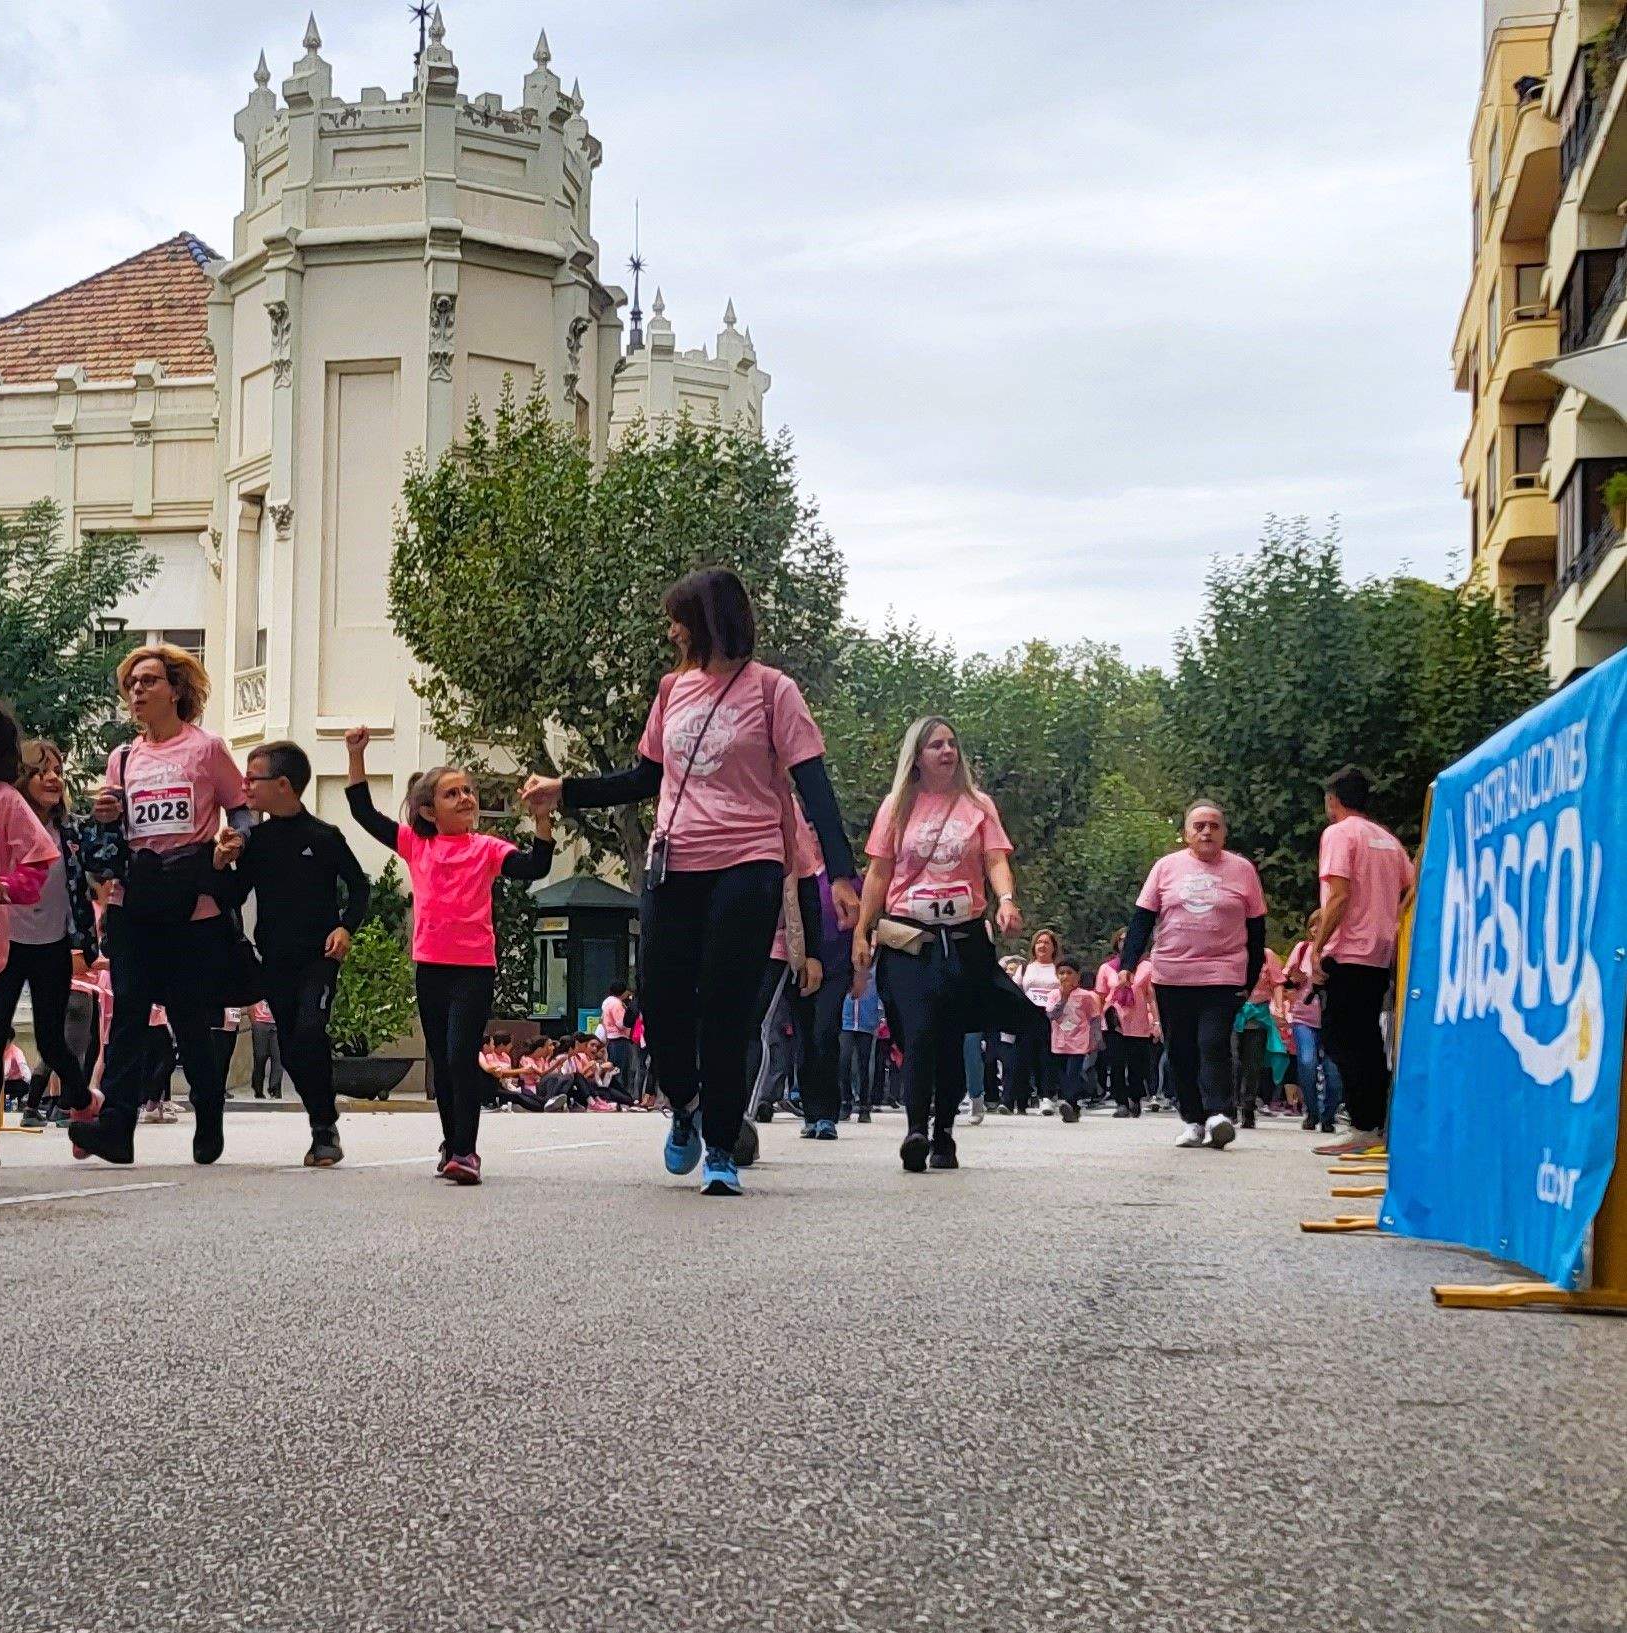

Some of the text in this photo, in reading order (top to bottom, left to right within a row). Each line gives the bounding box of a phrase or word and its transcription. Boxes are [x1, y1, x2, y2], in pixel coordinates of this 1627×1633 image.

[134, 801, 190, 825] 2028
[928, 900, 957, 918] 14
[1434, 793, 1584, 1027] blasco
